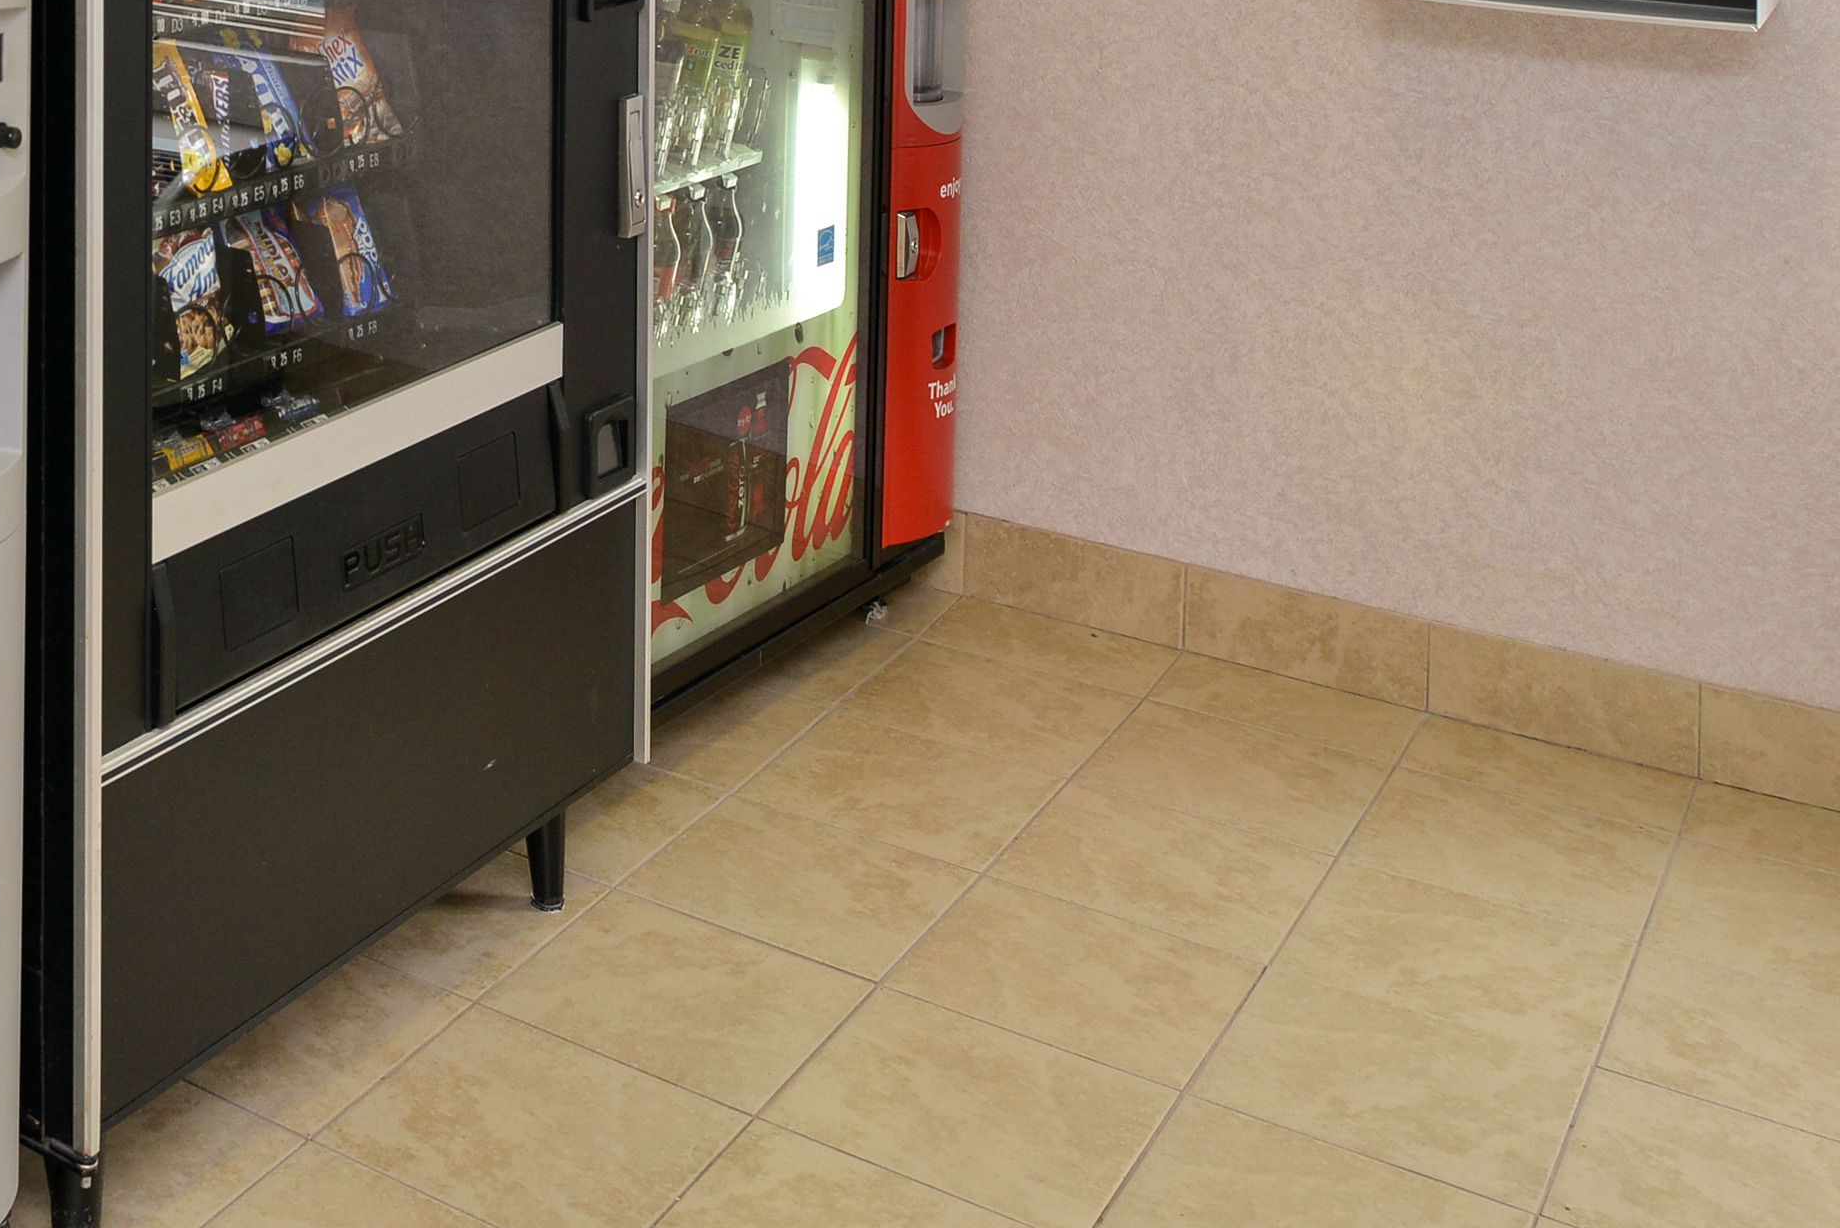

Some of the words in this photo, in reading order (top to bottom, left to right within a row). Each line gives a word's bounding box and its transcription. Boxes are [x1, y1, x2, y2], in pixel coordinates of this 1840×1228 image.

[171, 18, 184, 34] D3
[320, 29, 352, 64] hex
[369, 151, 380, 167] E8
[293, 174, 305, 190] E6
[254, 185, 265, 201] E5
[212, 196, 224, 212] E4
[169, 210, 181, 224] E3
[292, 348, 303, 364] F6
[212, 378, 223, 393] F4
[342, 520, 426, 588] PUSH
